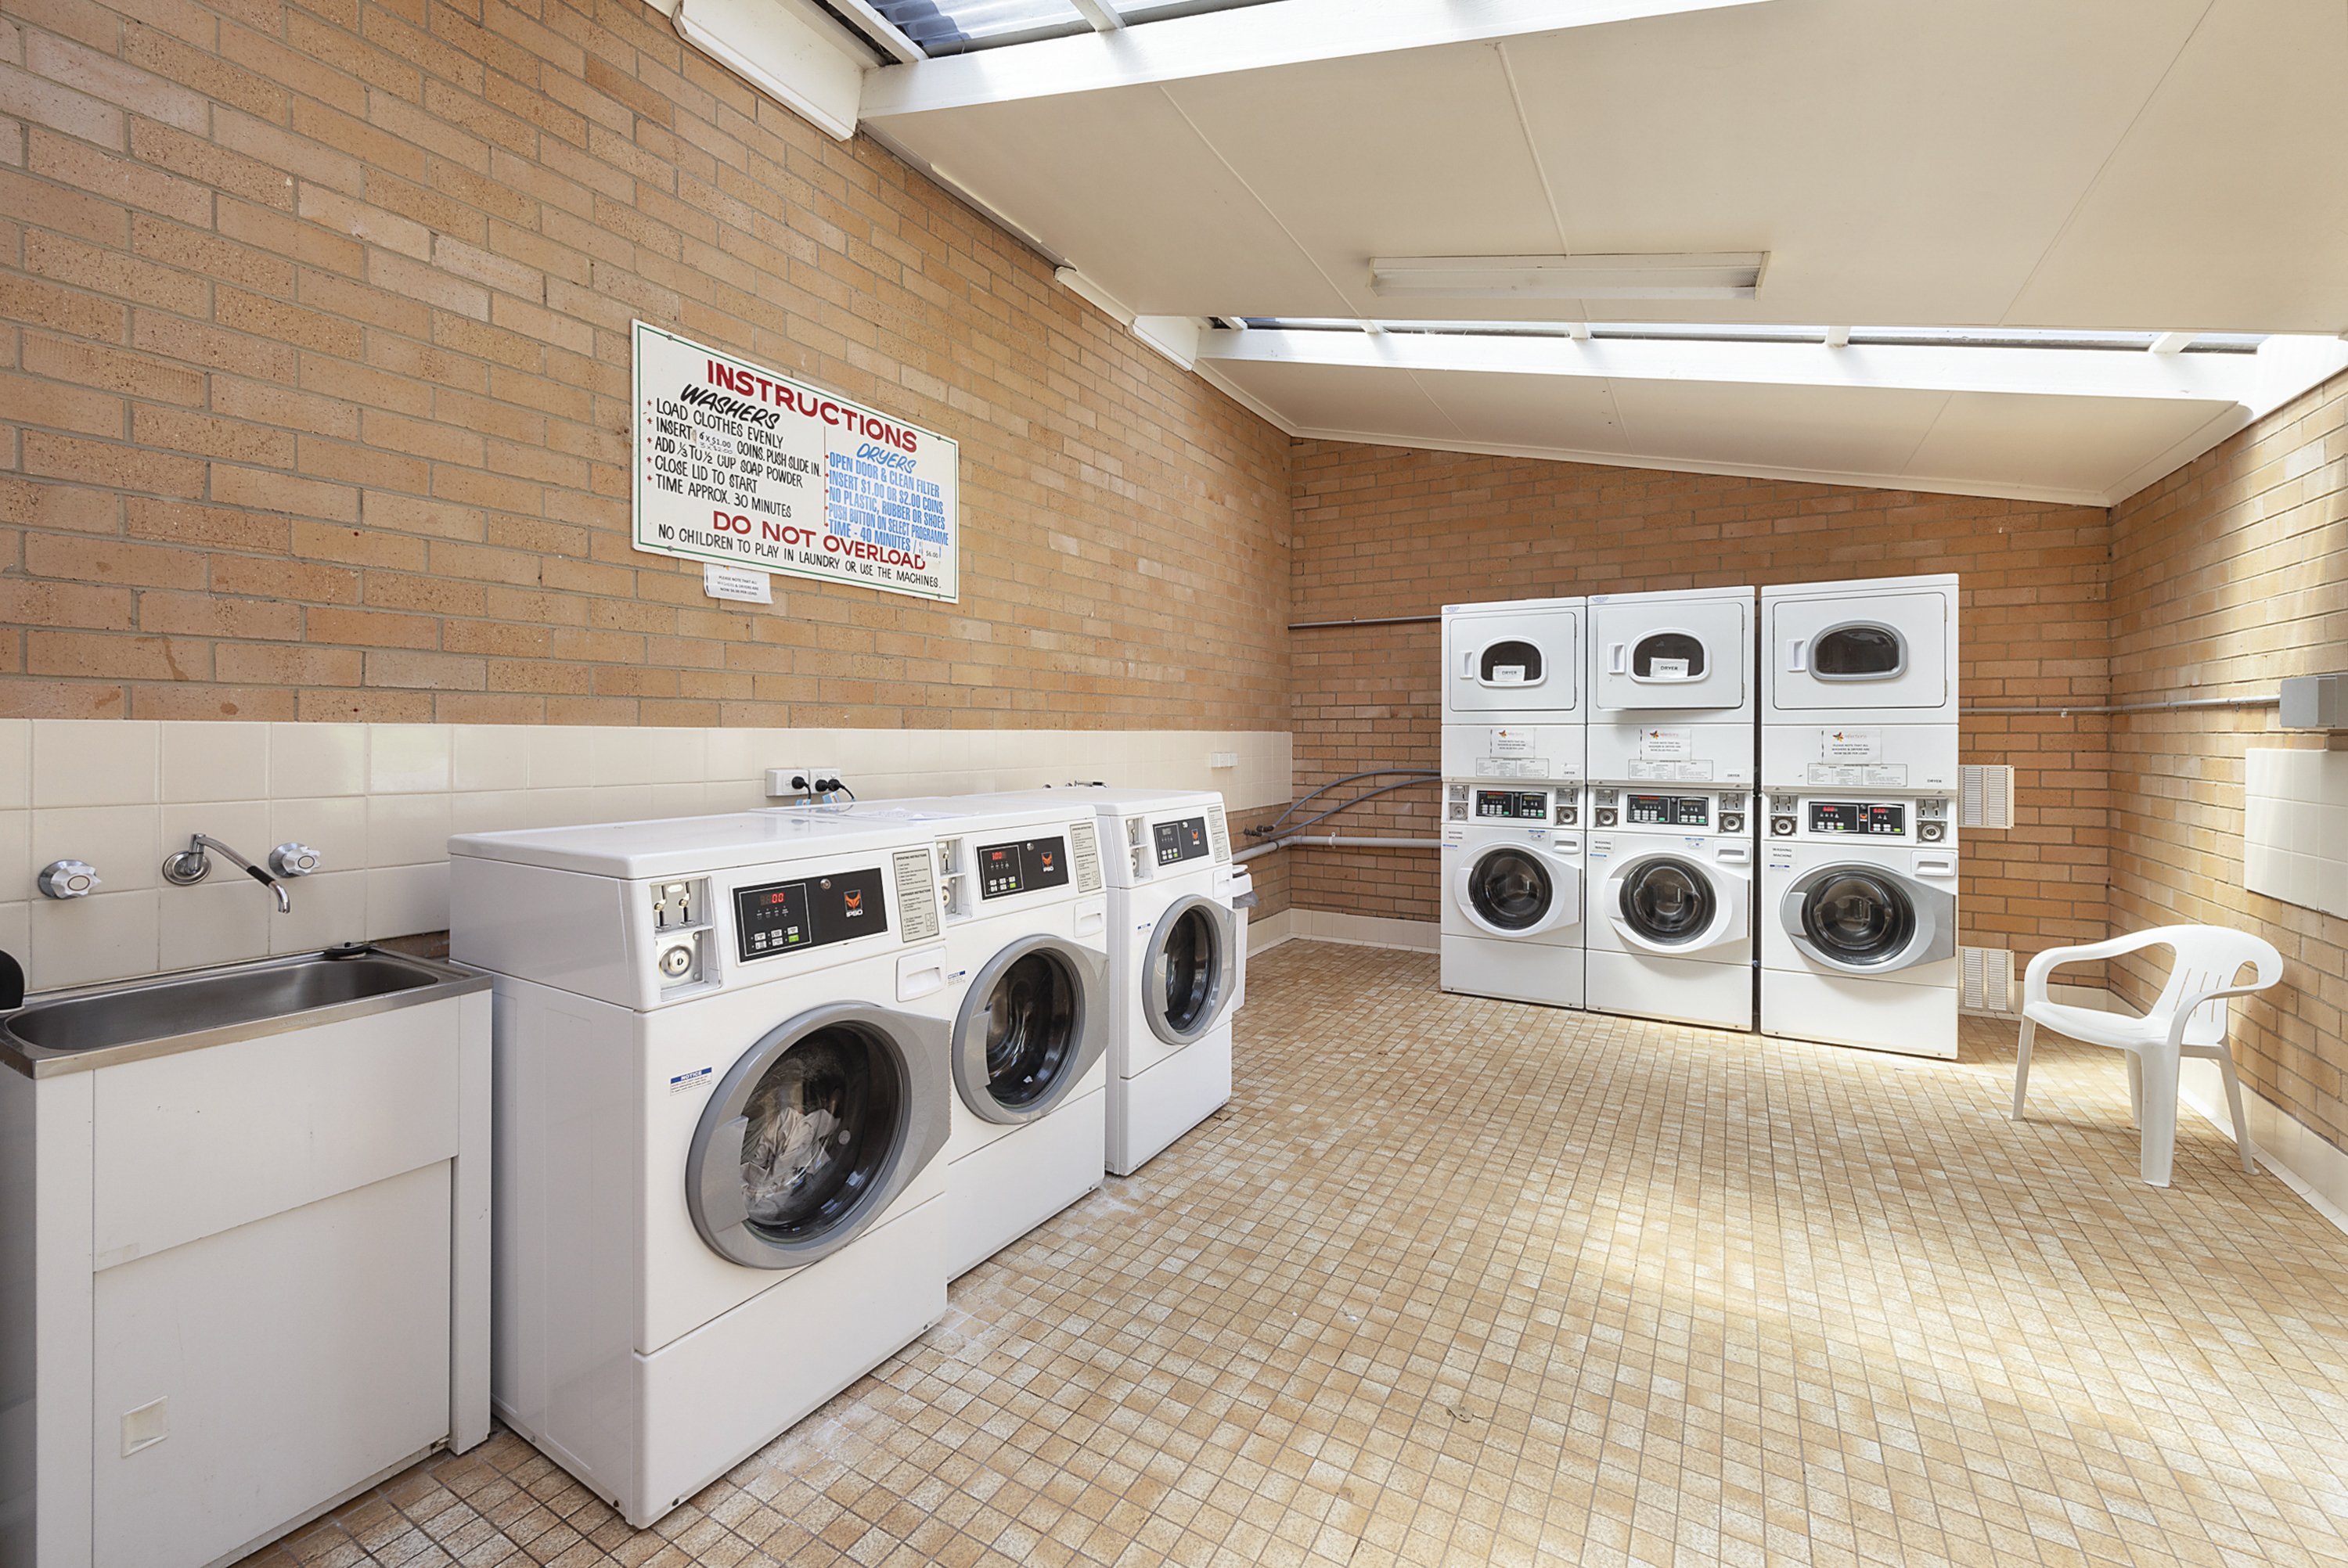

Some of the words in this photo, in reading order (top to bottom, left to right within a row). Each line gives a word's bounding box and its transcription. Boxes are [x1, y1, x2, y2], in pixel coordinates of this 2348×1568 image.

[657, 397, 688, 420] LOAD
[693, 410, 744, 438] CLOTHES
[747, 426, 783, 449] EVENLY
[680, 383, 780, 430] WASHERS
[707, 359, 917, 453] INSTRUCTIONS
[655, 436, 675, 454] ADD
[689, 444, 702, 461] TO
[717, 455, 736, 469] CUP
[740, 460, 763, 477] SOAP
[767, 466, 803, 488] POWDER
[656, 416, 693, 440] INSERT
[699, 431, 704, 440] 6
[711, 437, 732, 448] $1.00
[736, 441, 765, 462] COINS.
[766, 449, 787, 467] PUSH
[788, 455, 809, 474] SLIDE
[812, 462, 822, 477] IN.
[856, 443, 917, 473] DRYERS
[655, 455, 688, 477] CLOSE
[693, 464, 708, 480] LID
[711, 469, 725, 484] TO
[729, 474, 758, 494] START
[656, 473, 683, 494] TIME
[688, 482, 730, 505] APPROX.
[734, 493, 747, 508] 30
[751, 497, 791, 518] MINUTES
[829, 469, 859, 491] INSERT
[861, 479, 884, 498] $1.00
[887, 486, 897, 502] OR
[899, 490, 921, 509] $2.00
[923, 497, 943, 515] COINS
[830, 451, 852, 472] OPEN
[855, 459, 878, 480] DOOR
[880, 467, 887, 483] &
[889, 470, 914, 491] CLEAN
[917, 479, 940, 498] FILTER
[829, 487, 841, 503] NO
[844, 491, 880, 515] PLASTIC,
[881, 501, 910, 522] RUBBER
[913, 509, 922, 523] OR
[924, 512, 945, 530] SHOES
[829, 503, 848, 521] PUSH
[849, 508, 876, 528] BUTTON
[877, 516, 886, 531] ON
[888, 519, 909, 538] SELECT
[911, 523, 949, 546] PROGRAMME
[658, 523, 675, 540] NO
[679, 528, 733, 550] CHILDREN
[737, 539, 751, 553] TO
[755, 542, 779, 559] PLAY
[784, 548, 794, 561] IN
[799, 552, 840, 570] LAUNDRY
[845, 560, 857, 574] OR
[861, 563, 873, 577] USE
[877, 566, 891, 579] THE
[896, 570, 941, 588] MACHINES.
[713, 510, 752, 534] DO
[762, 520, 816, 548] NOT
[823, 535, 926, 570] OVERLOAD
[829, 519, 852, 538] TIME
[860, 527, 872, 543] 40
[874, 530, 911, 552] MINUTES
[681, 1070, 702, 1081] NOTICE
